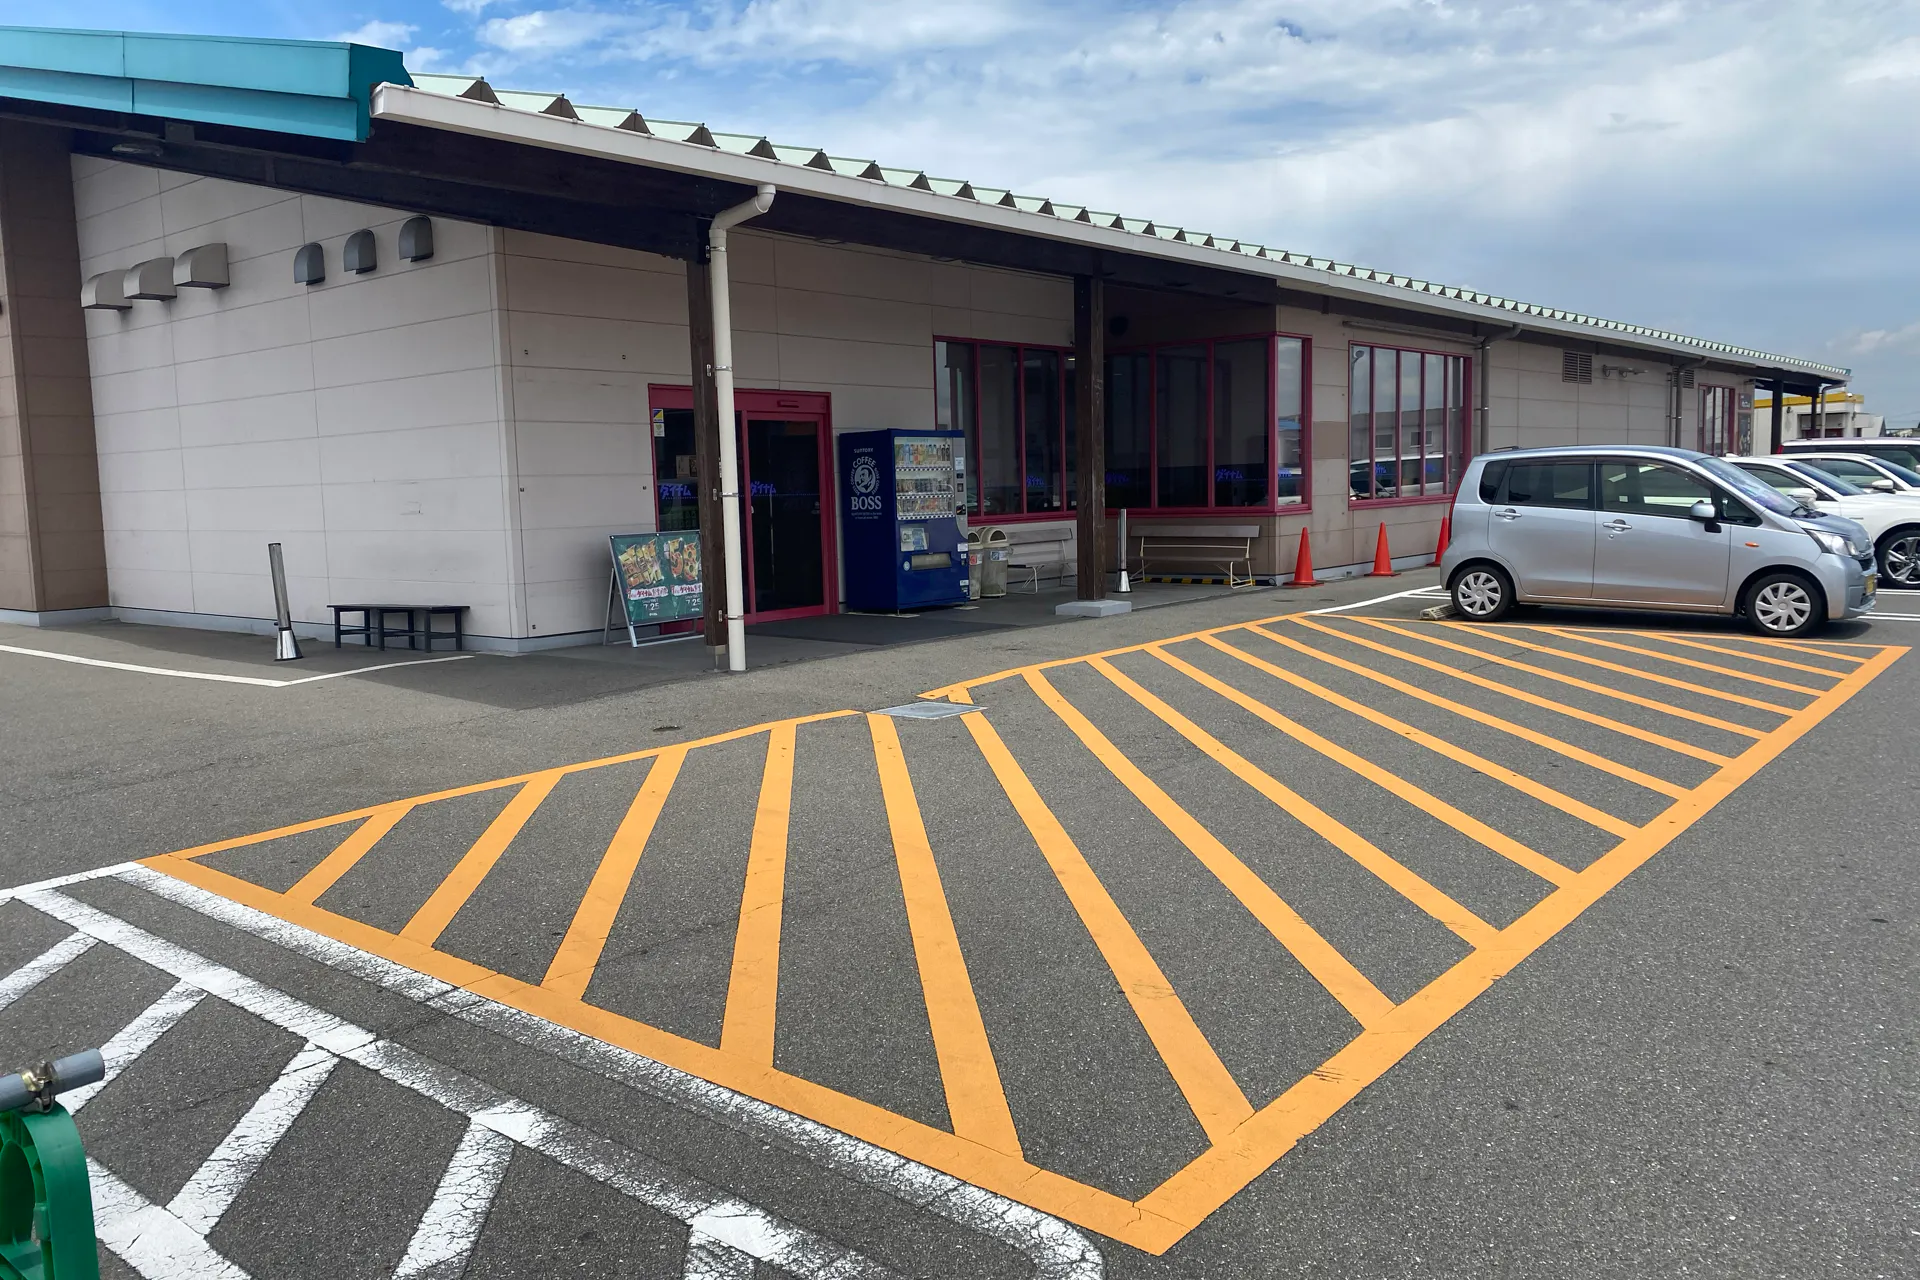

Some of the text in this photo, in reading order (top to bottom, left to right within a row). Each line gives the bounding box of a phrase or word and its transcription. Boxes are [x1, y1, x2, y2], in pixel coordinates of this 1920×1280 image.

[852, 456, 877, 469] COFFEE
[660, 484, 691, 499] ダイナム
[851, 495, 882, 510] BOSS
[669, 538, 698, 581] 58
